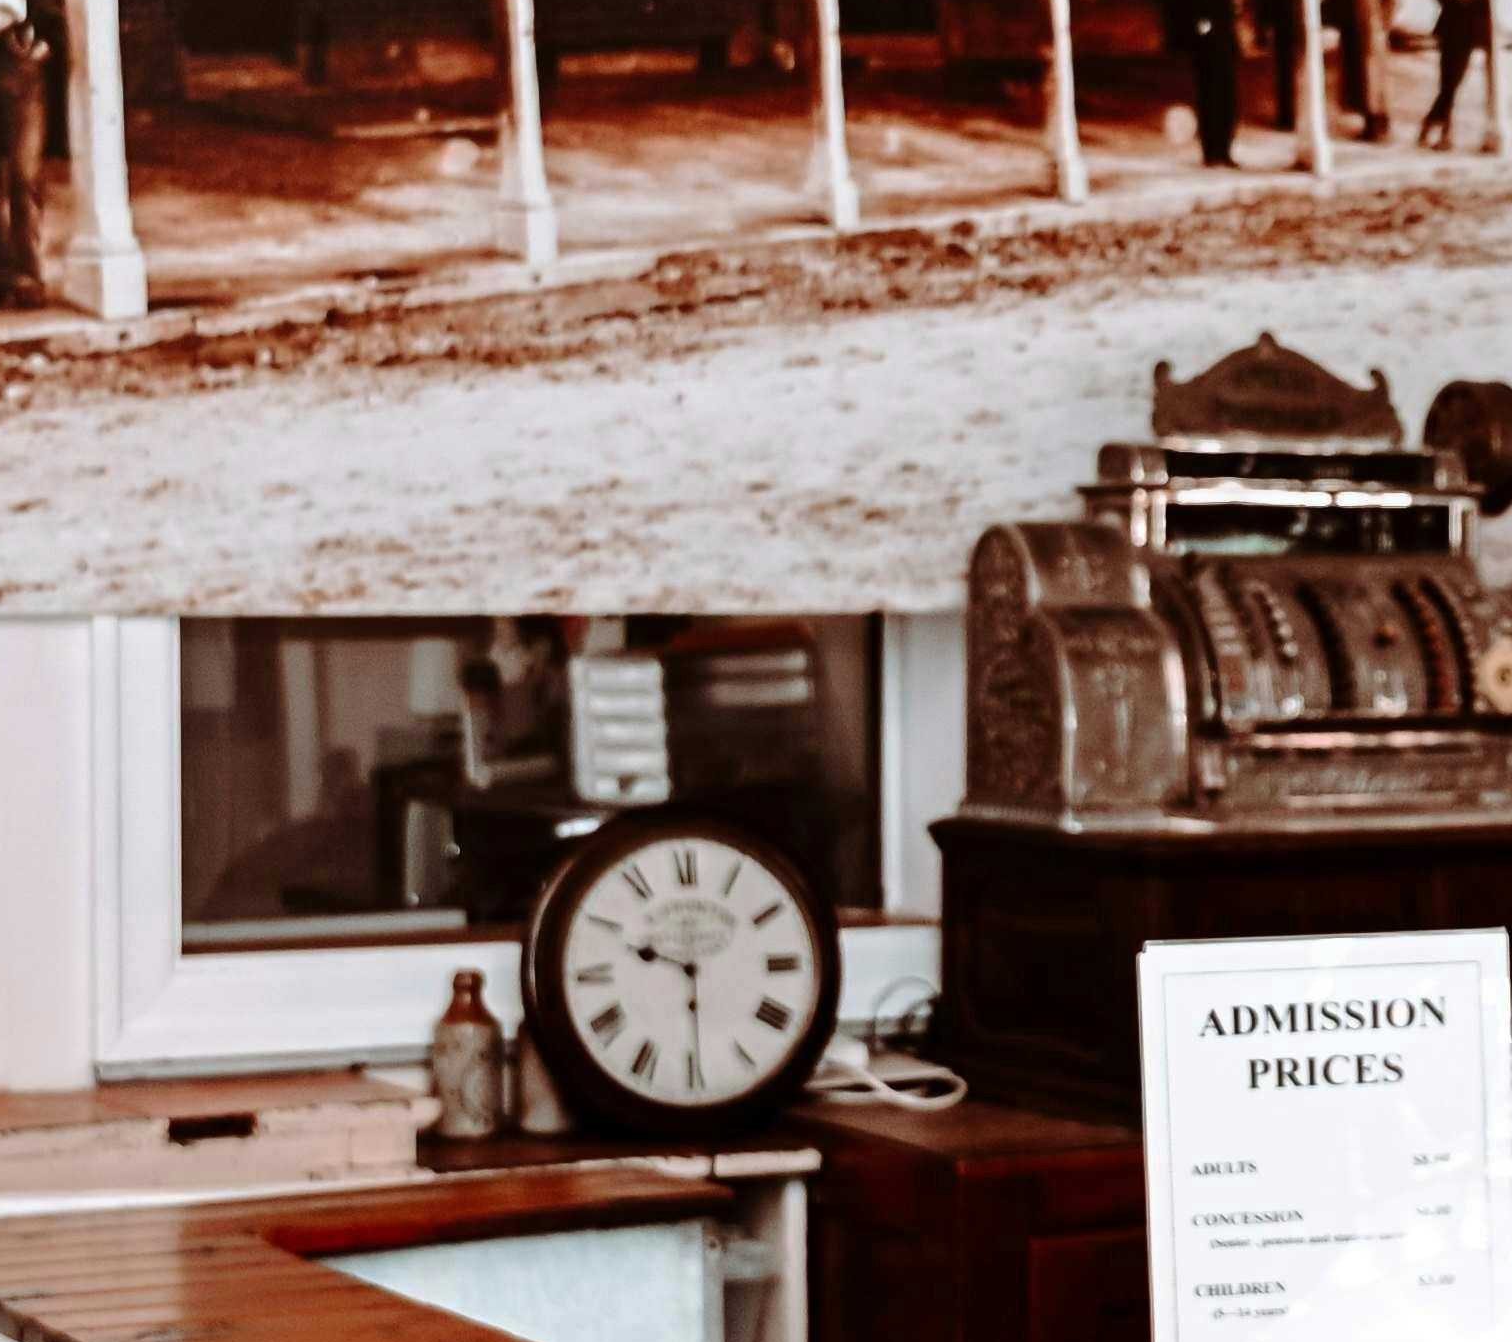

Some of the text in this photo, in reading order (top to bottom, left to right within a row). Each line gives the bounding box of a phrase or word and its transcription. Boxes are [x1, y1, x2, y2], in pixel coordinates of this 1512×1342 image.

[1197, 994, 1449, 1039] ADMISSION
[1246, 1052, 1406, 1091] PRICES
[1191, 1159, 1258, 1176] ADULTS
[1191, 1209, 1305, 1227] CONCESSION
[1194, 1280, 1286, 1297] CHILDREN
